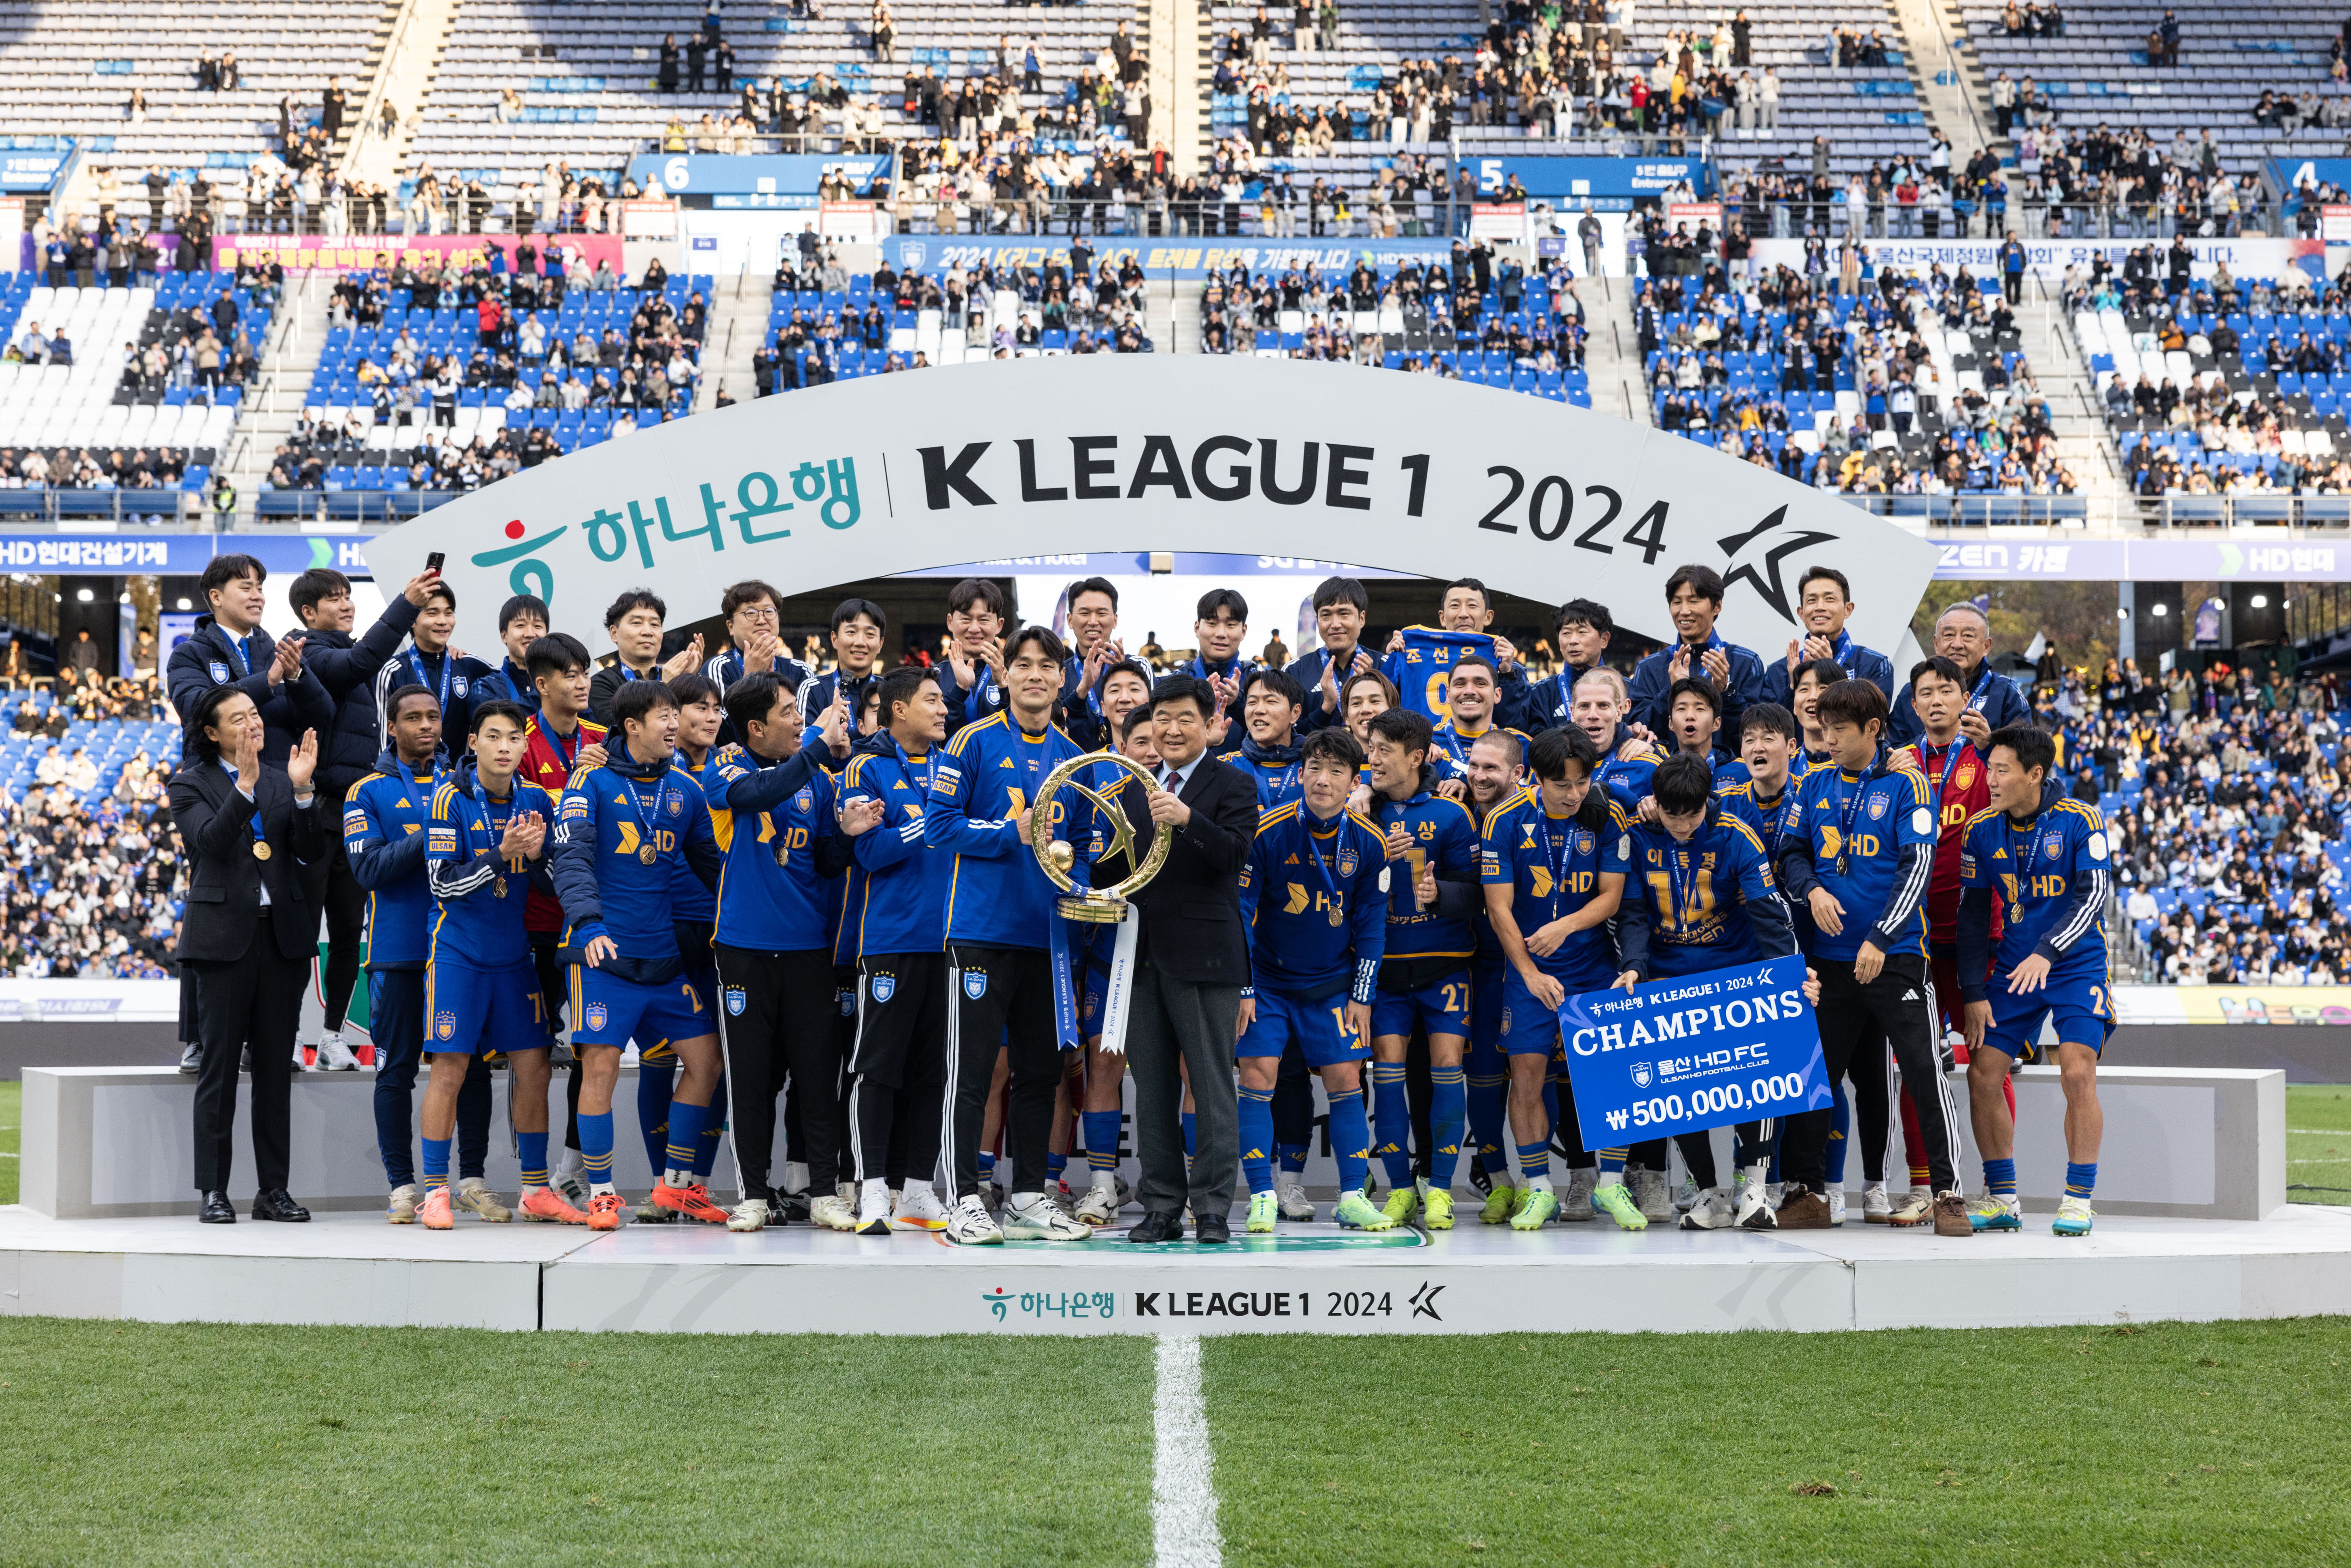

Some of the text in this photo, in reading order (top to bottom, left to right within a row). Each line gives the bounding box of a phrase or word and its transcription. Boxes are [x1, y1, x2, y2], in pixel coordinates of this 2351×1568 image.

[665, 157, 689, 189] 6
[1481, 160, 1503, 191] 5
[2293, 161, 2319, 192] 4
[938, 246, 992, 267] 2024
[581, 456, 861, 569] 하나은행
[916, 435, 1670, 566] K LEAGUE 1 2024
[0, 541, 168, 566] HD현대건설기계
[2248, 547, 2335, 572] HD현대
[1051, 800, 1064, 823] D
[346, 822, 365, 835] ULSAN
[1418, 821, 1436, 840] 상
[1849, 835, 1879, 856] HD
[1647, 848, 1662, 867] 이
[1700, 852, 1716, 870] 경
[1560, 871, 1594, 893] HD
[2031, 875, 2066, 897] HD
[1646, 868, 1716, 932] 14
[1441, 983, 1469, 1013] 27
[1604, 976, 1754, 1013] 하나은행 K LEAGUE 1 2024
[1572, 990, 1803, 1056] CHAMPIONS
[1658, 1043, 1768, 1076] 울산 HD FC
[1660, 1074, 1689, 1084] ULSAN
[1702, 1064, 1746, 1078] FOOTBALL
[1746, 1059, 1770, 1069] CLUB
[1020, 1292, 1393, 1318] 하나은행 K LEAGUE 1 2024
